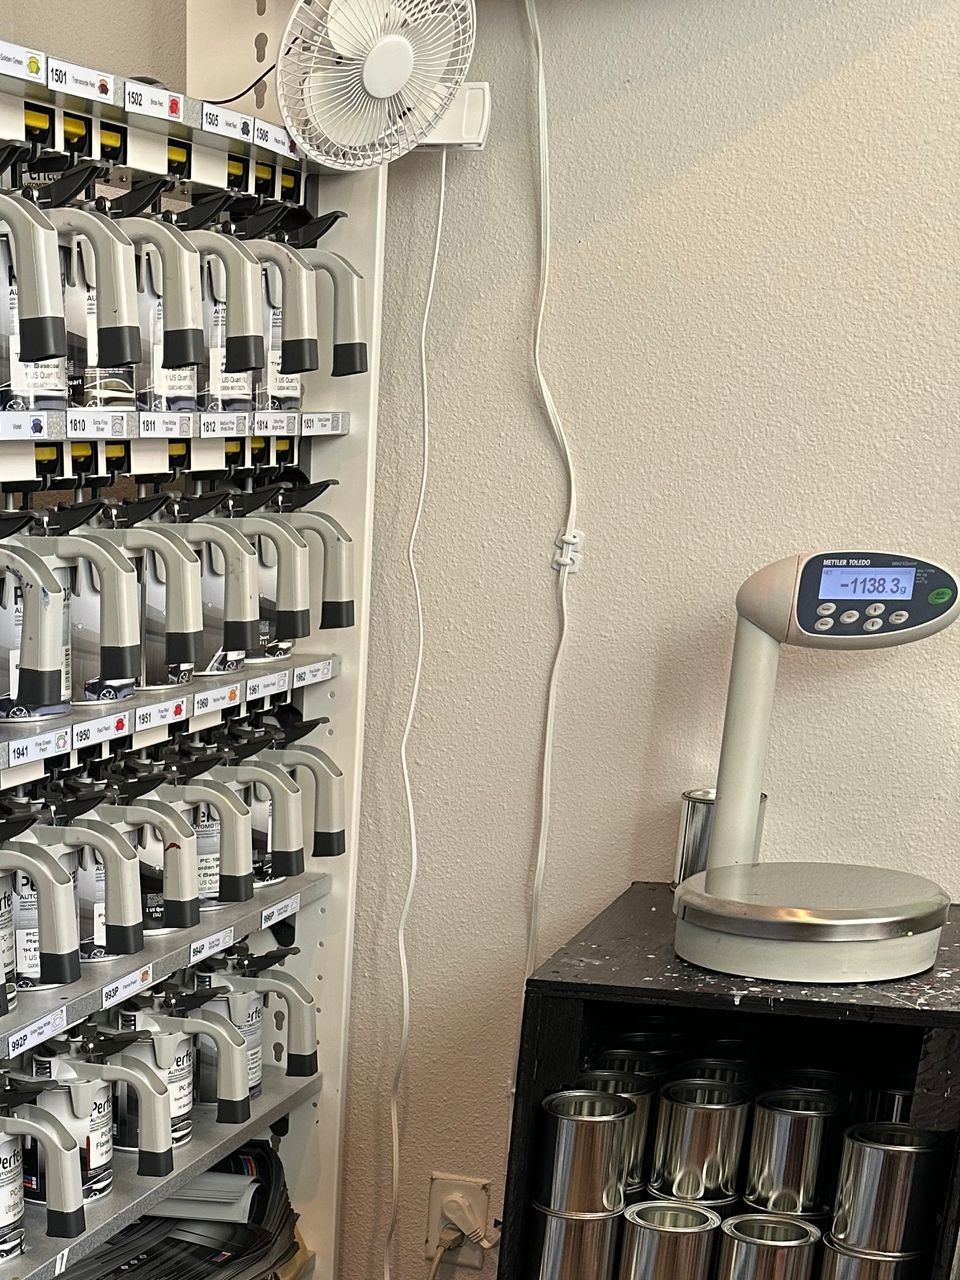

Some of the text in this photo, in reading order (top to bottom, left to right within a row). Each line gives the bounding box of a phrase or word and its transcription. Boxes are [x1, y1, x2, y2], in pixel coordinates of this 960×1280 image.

[50, 68, 67, 84] 1501
[128, 91, 142, 106] 1502
[205, 113, 218, 127] 1505
[257, 128, 269, 142] 1506
[70, 419, 86, 432] 1810
[143, 419, 156, 432] 1811
[203, 421, 216, 433] 1812
[257, 420, 268, 431] 1814
[304, 418, 314, 430] 1831
[296, 671, 306, 682] 1962
[139, 712, 151, 726] 1951
[75, 729, 90, 743] 1950
[12, 746, 29, 760] 1941
[105, 986, 119, 1002] 993P
[11, 1034, 27, 1052] 992P
